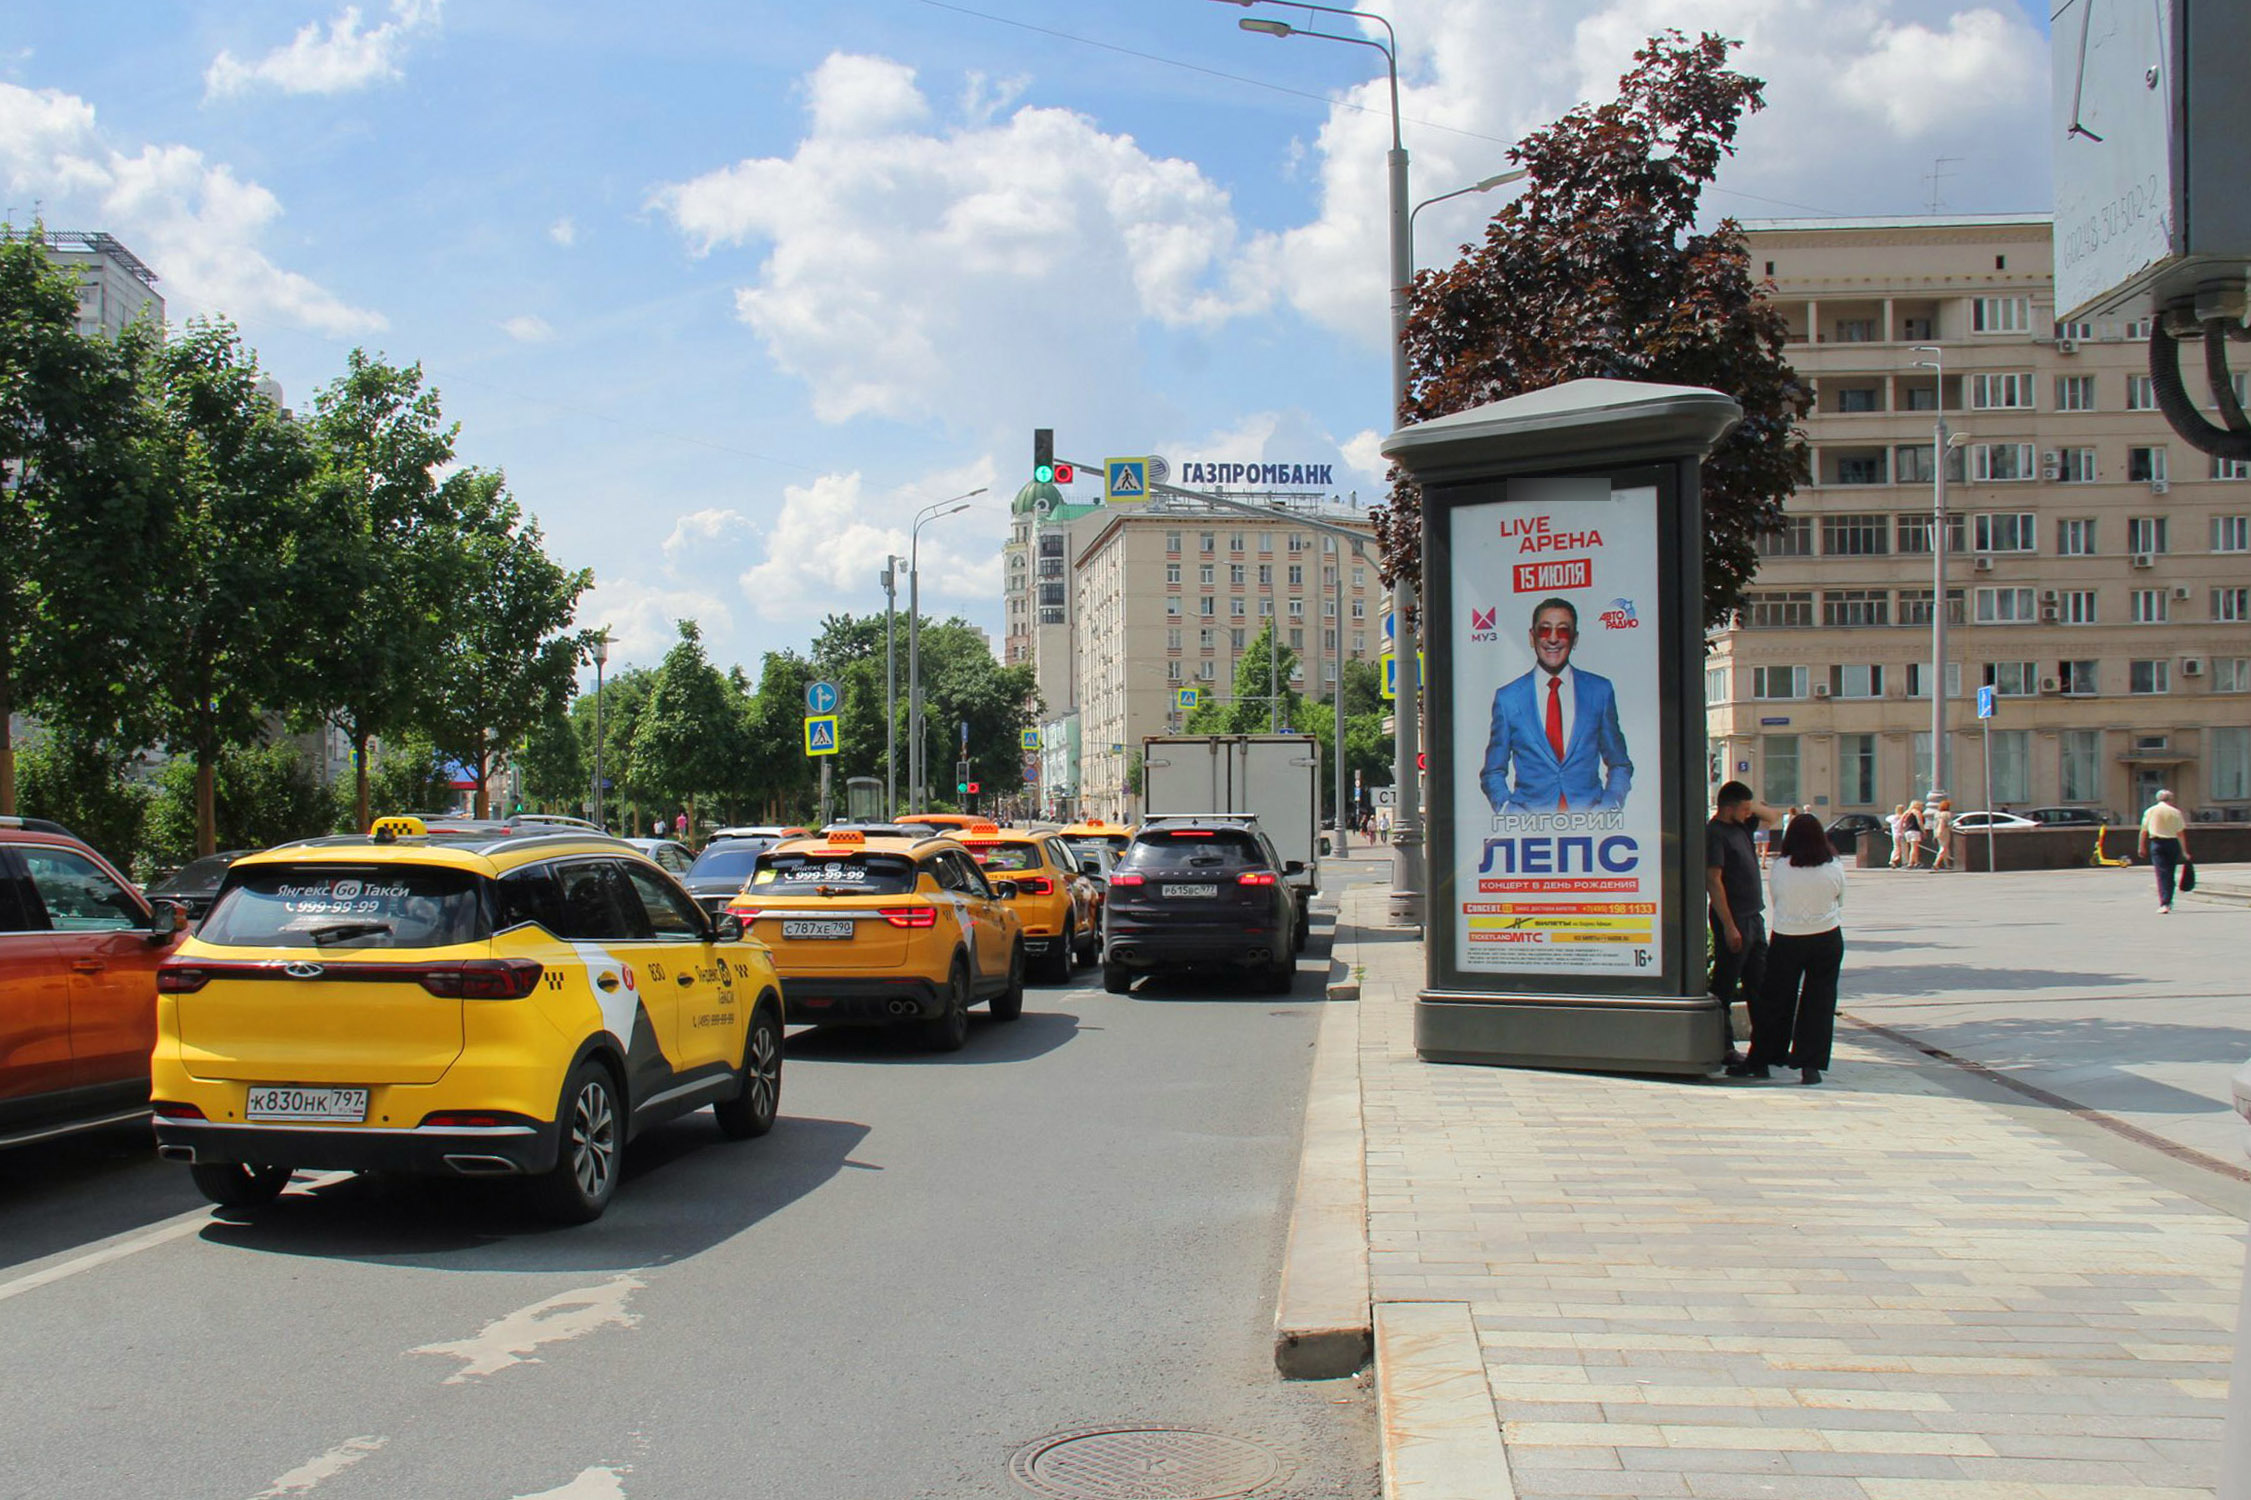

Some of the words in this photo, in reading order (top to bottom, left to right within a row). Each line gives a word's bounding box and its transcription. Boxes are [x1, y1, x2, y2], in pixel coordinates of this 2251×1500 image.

[1183, 463, 1333, 485] ГАЗПРОМБАНК
[1500, 516, 1550, 537] LIVE
[1519, 530, 1604, 554] АРЕНА
[1519, 566, 1535, 589] 15
[1538, 562, 1586, 588] ИЮЛЯ
[1598, 610, 1625, 621] АВТО
[1606, 618, 1639, 630] РАДИО
[1472, 632, 1498, 642] МУЗ
[1492, 808, 1625, 832] ГРИГОРИЙ
[1478, 835, 1639, 873] ЛЕПС
[795, 871, 865, 880] 999-99-99
[364, 883, 410, 897] Такси
[1480, 881, 1529, 890] КОНЦЕРТ
[1532, 881, 1539, 889] В
[1543, 881, 1571, 889] ДЕНЬ
[1574, 880, 1637, 889] РОЖДЕНИЯ
[297, 900, 380, 913] 999-99-99
[1629, 903, 1653, 914] 1133
[785, 922, 830, 934] С787ХЕ
[1634, 949, 1653, 967] 16+
[647, 963, 666, 982] 830
[253, 1090, 328, 1112] К830НК
[333, 1091, 363, 1107] 797
